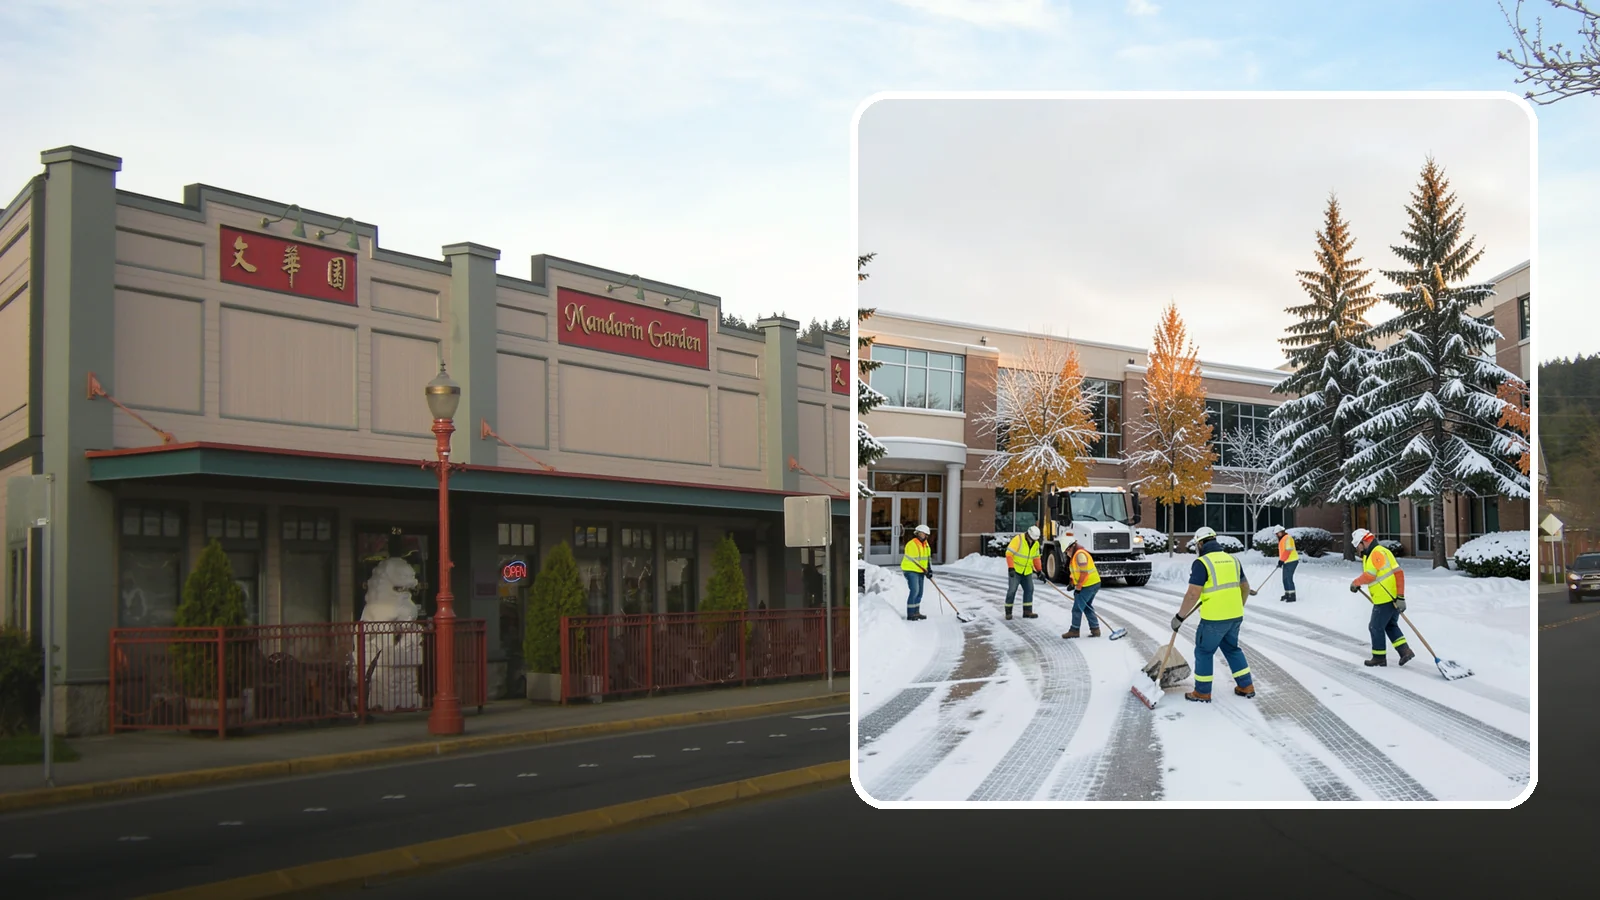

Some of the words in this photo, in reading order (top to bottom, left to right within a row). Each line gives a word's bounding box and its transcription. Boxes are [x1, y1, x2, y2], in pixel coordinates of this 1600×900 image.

[231, 235, 346, 291] 文華園
[564, 302, 644, 341] Mandarin
[648, 320, 701, 352] Garden
[503, 565, 527, 578] OPEN
